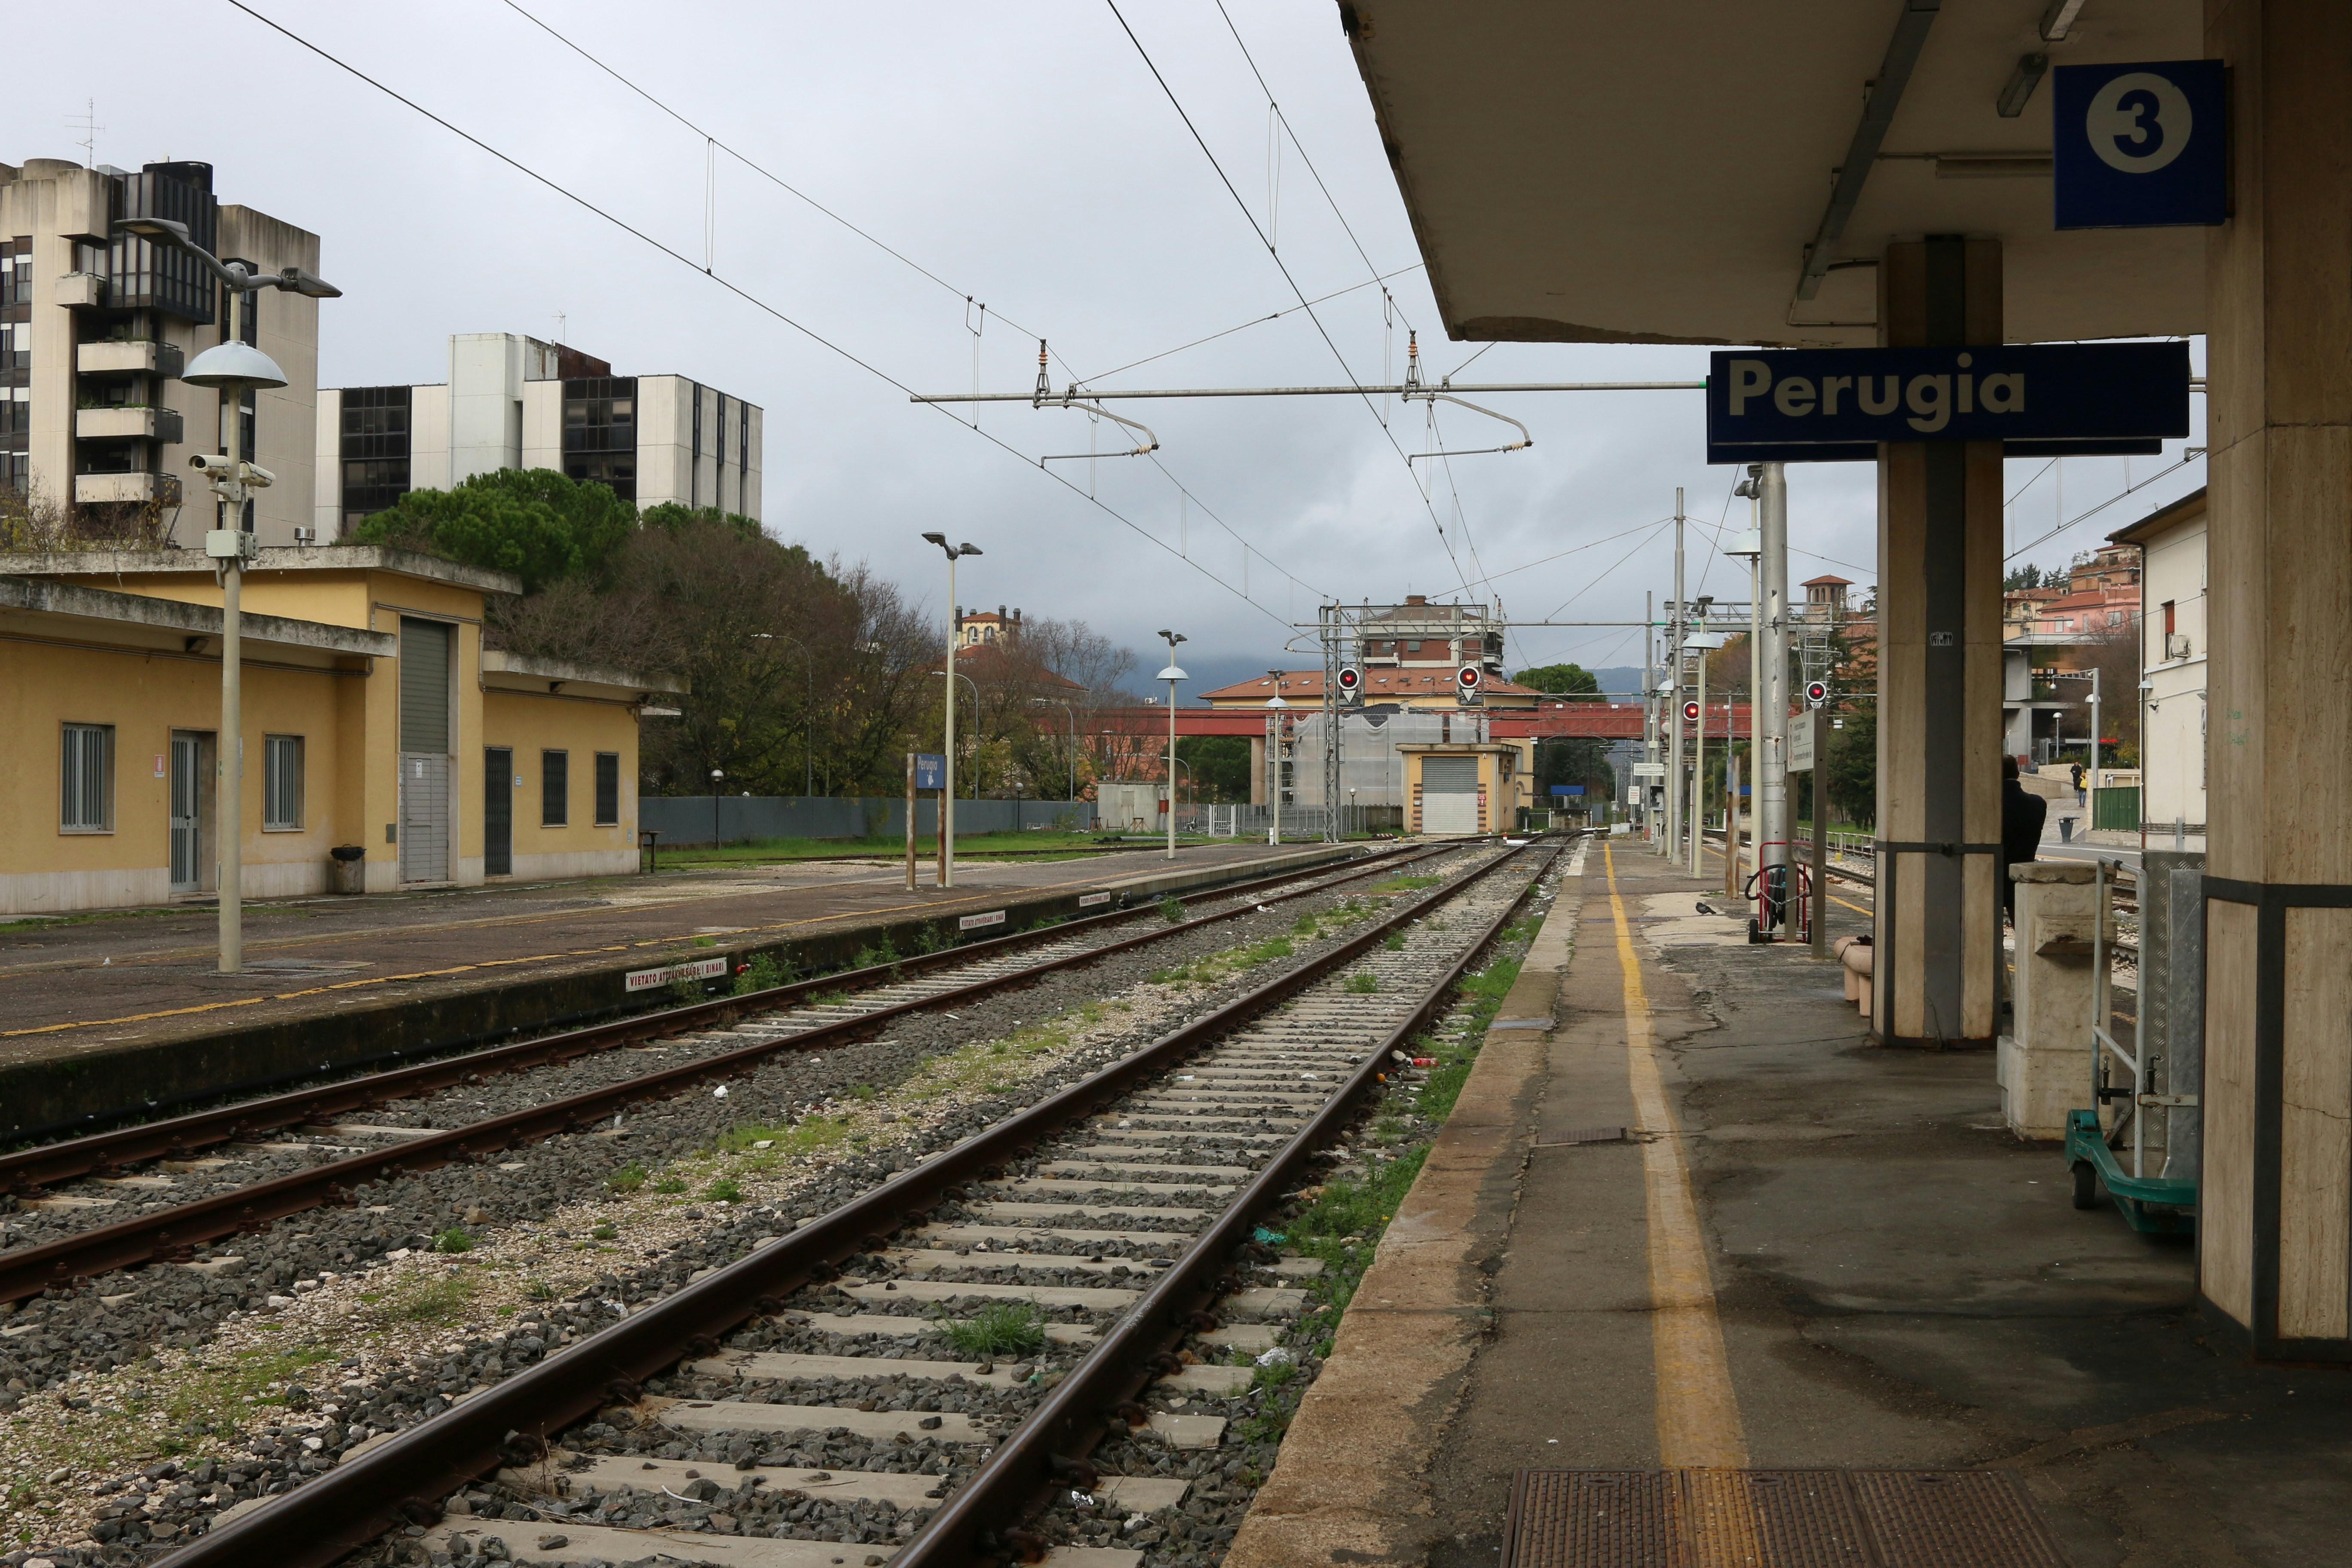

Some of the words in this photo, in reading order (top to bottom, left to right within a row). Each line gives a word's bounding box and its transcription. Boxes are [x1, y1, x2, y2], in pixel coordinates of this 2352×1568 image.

[2113, 89, 2164, 158] 3
[1729, 352, 2025, 433] Perugia
[918, 756, 937, 774] Perugia
[630, 973, 657, 986] VIETATO
[702, 965, 704, 974] I
[706, 962, 724, 973] BINARI
